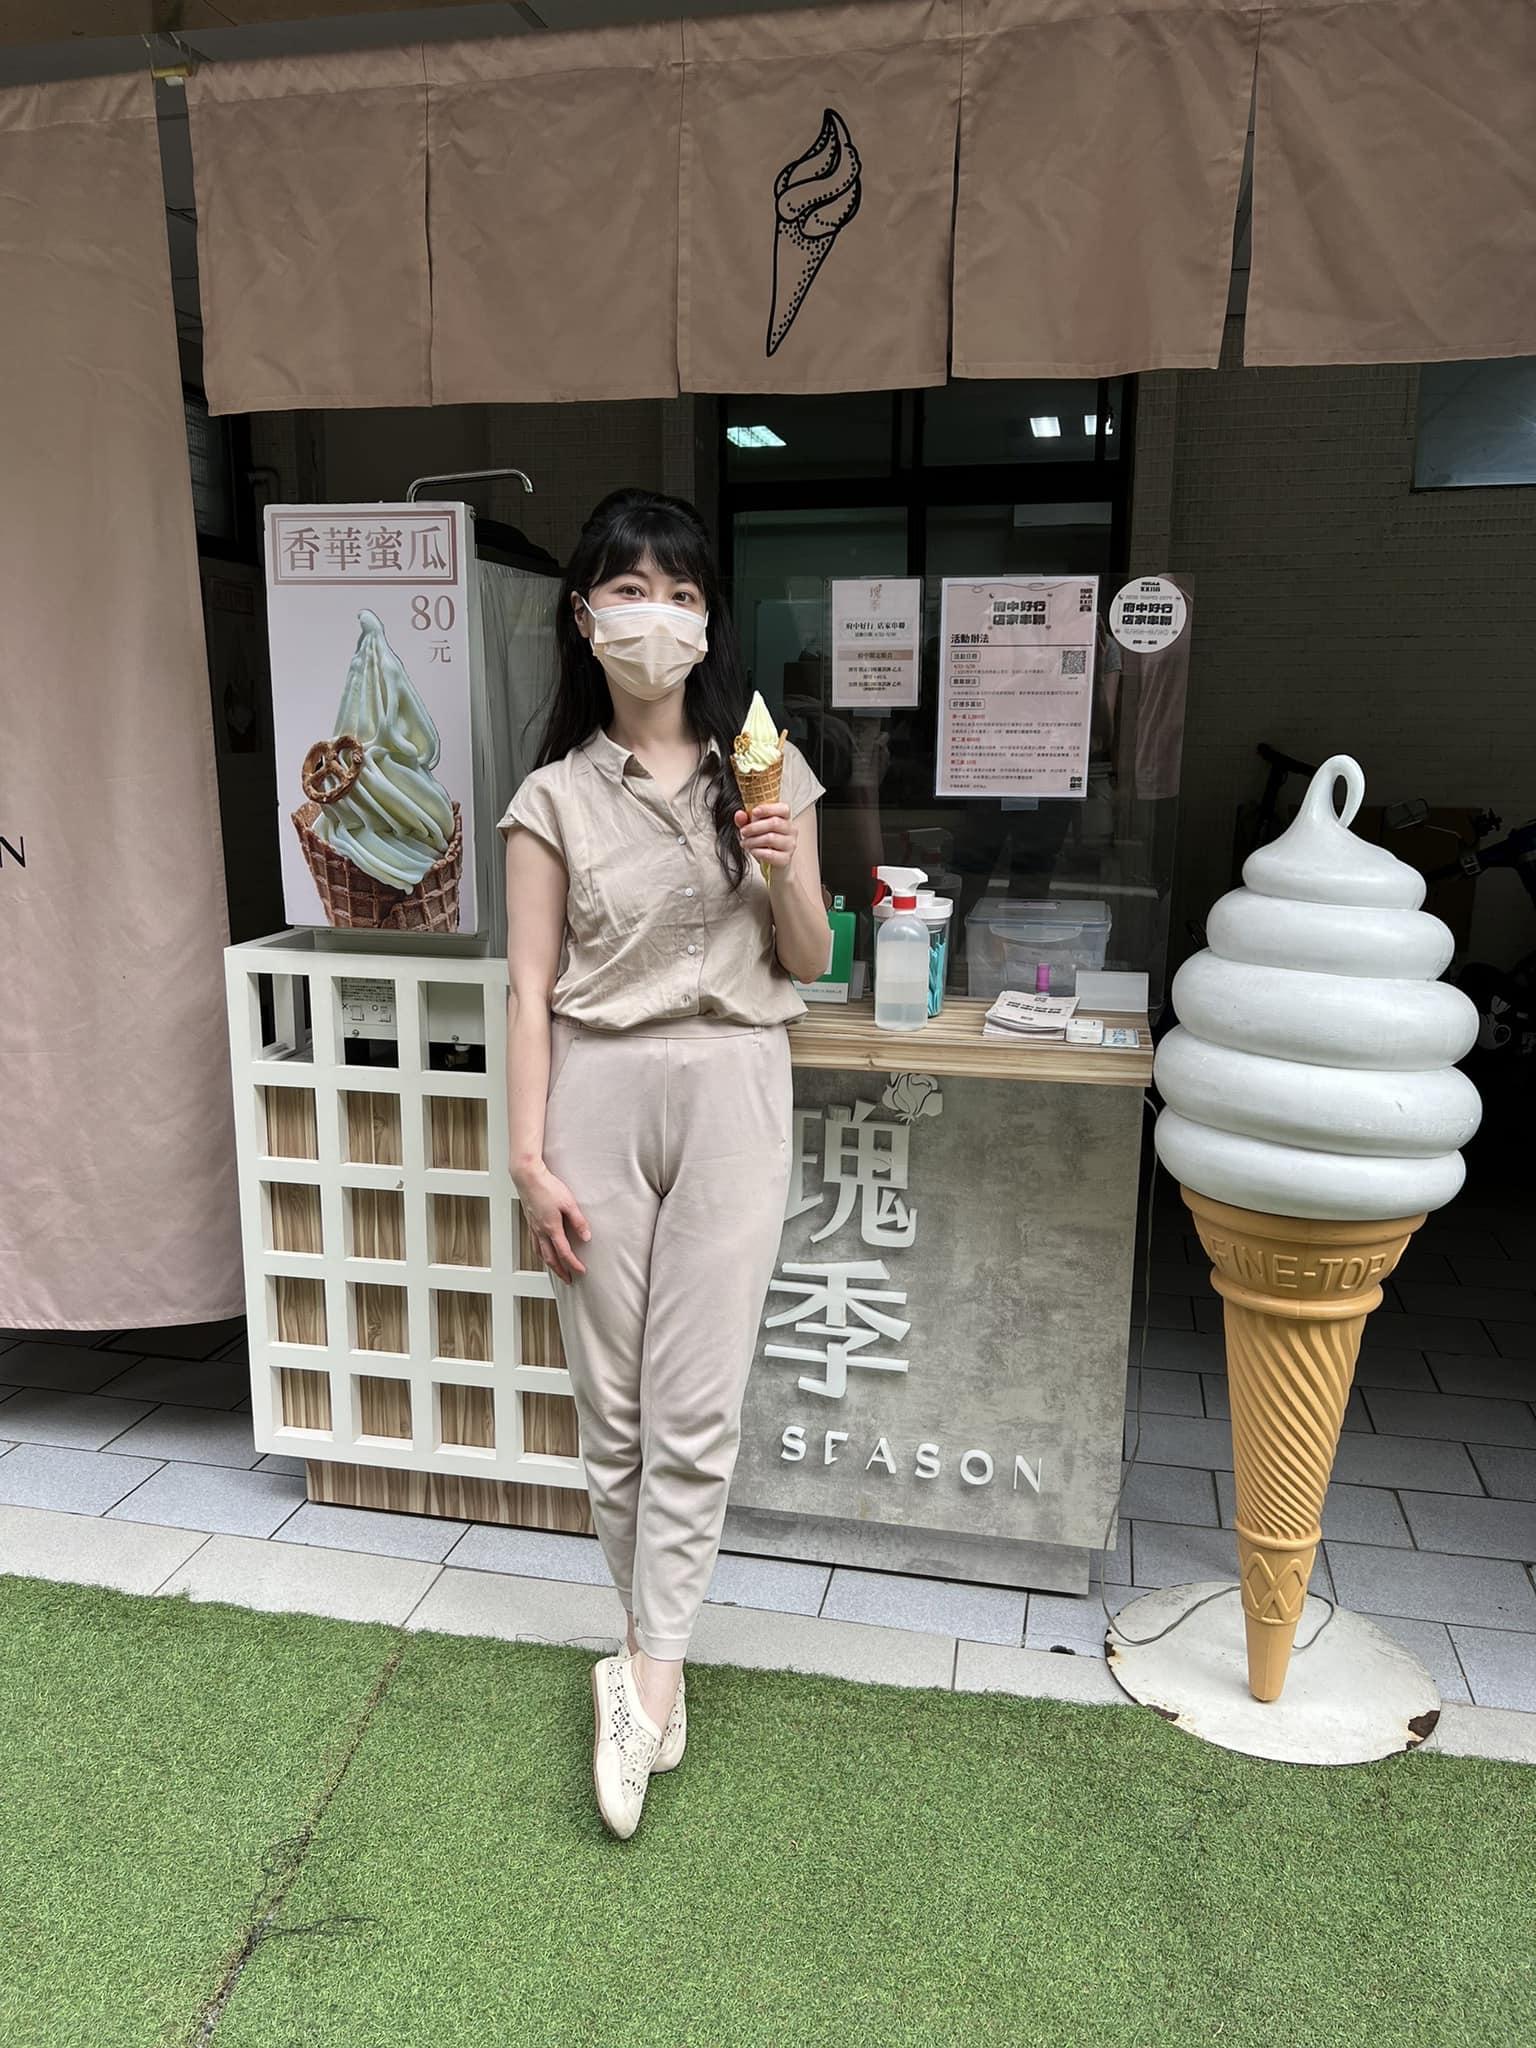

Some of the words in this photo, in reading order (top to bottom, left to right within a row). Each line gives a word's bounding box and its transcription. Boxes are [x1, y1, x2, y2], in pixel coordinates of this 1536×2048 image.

[282, 525, 447, 572] 香華蜜瓜
[411, 595, 456, 631] 80
[994, 601, 1046, 612] 府中好行
[1123, 603, 1173, 613] 府中好行
[430, 639, 452, 664] 元
[780, 1425, 1042, 1494] SEASON
